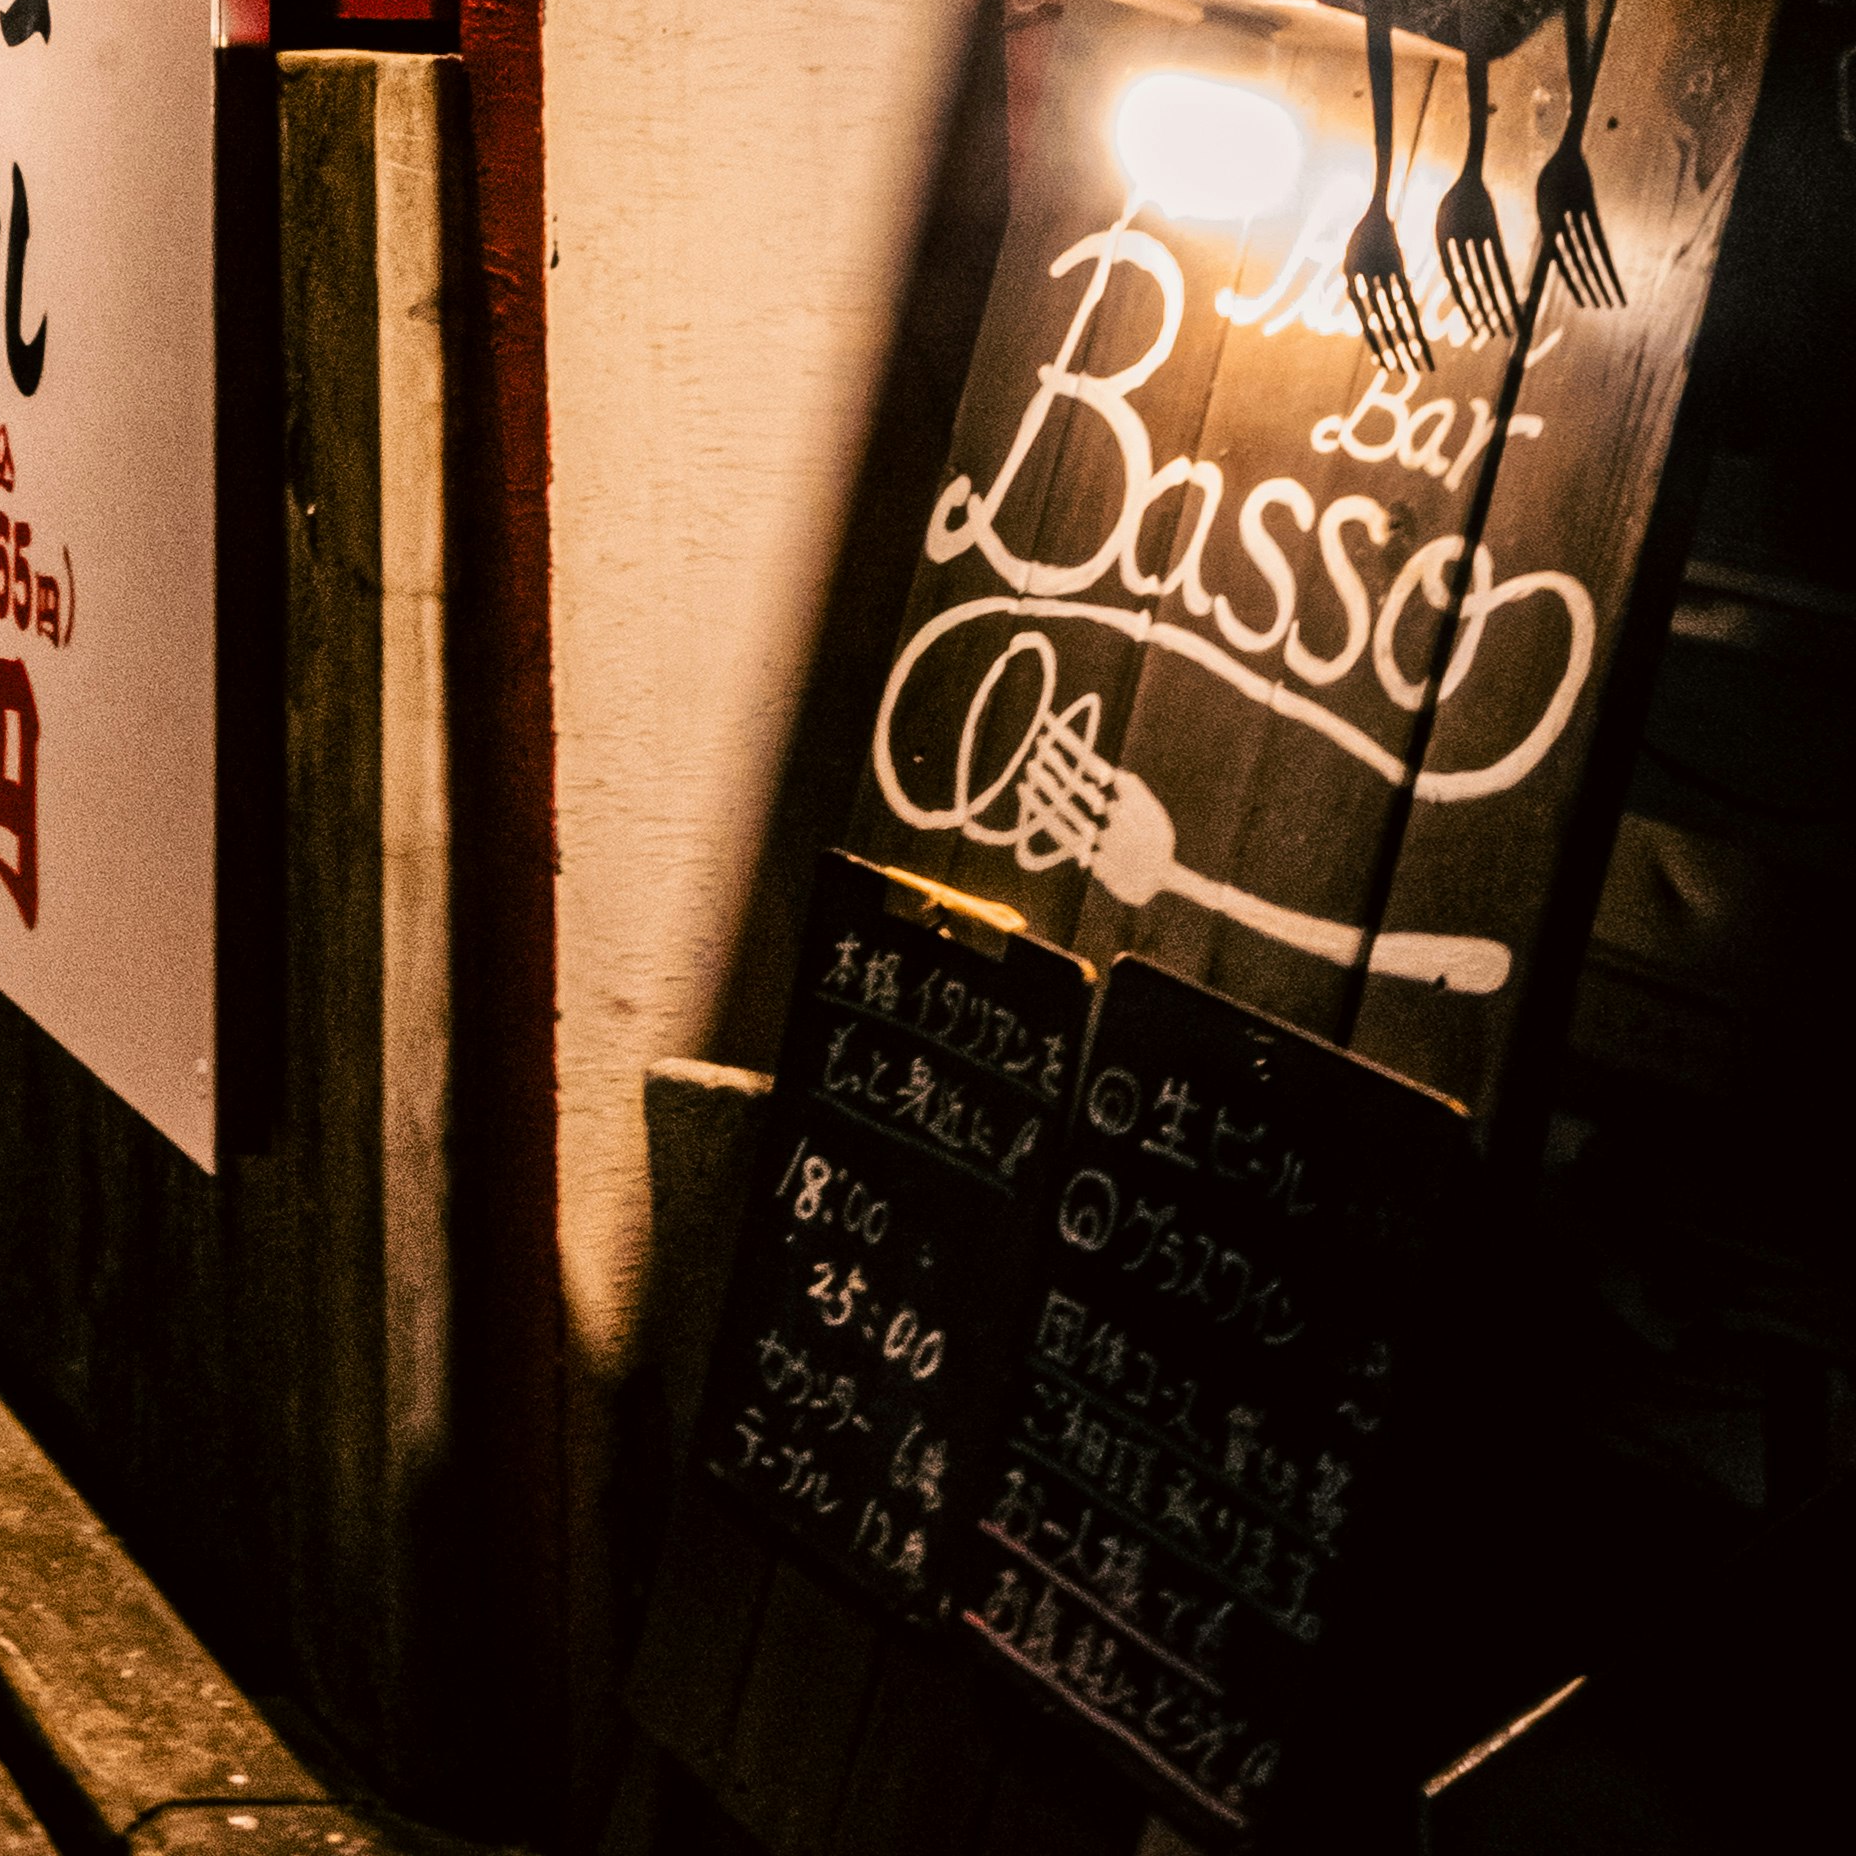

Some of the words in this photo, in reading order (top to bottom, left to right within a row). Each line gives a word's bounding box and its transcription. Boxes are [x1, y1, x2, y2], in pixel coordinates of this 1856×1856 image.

[926, 229, 1507, 711] Basso
[1312, 362, 1543, 489] Bar
[774, 1137, 892, 1246] 18:00
[806, 1258, 948, 1382] 25:00
